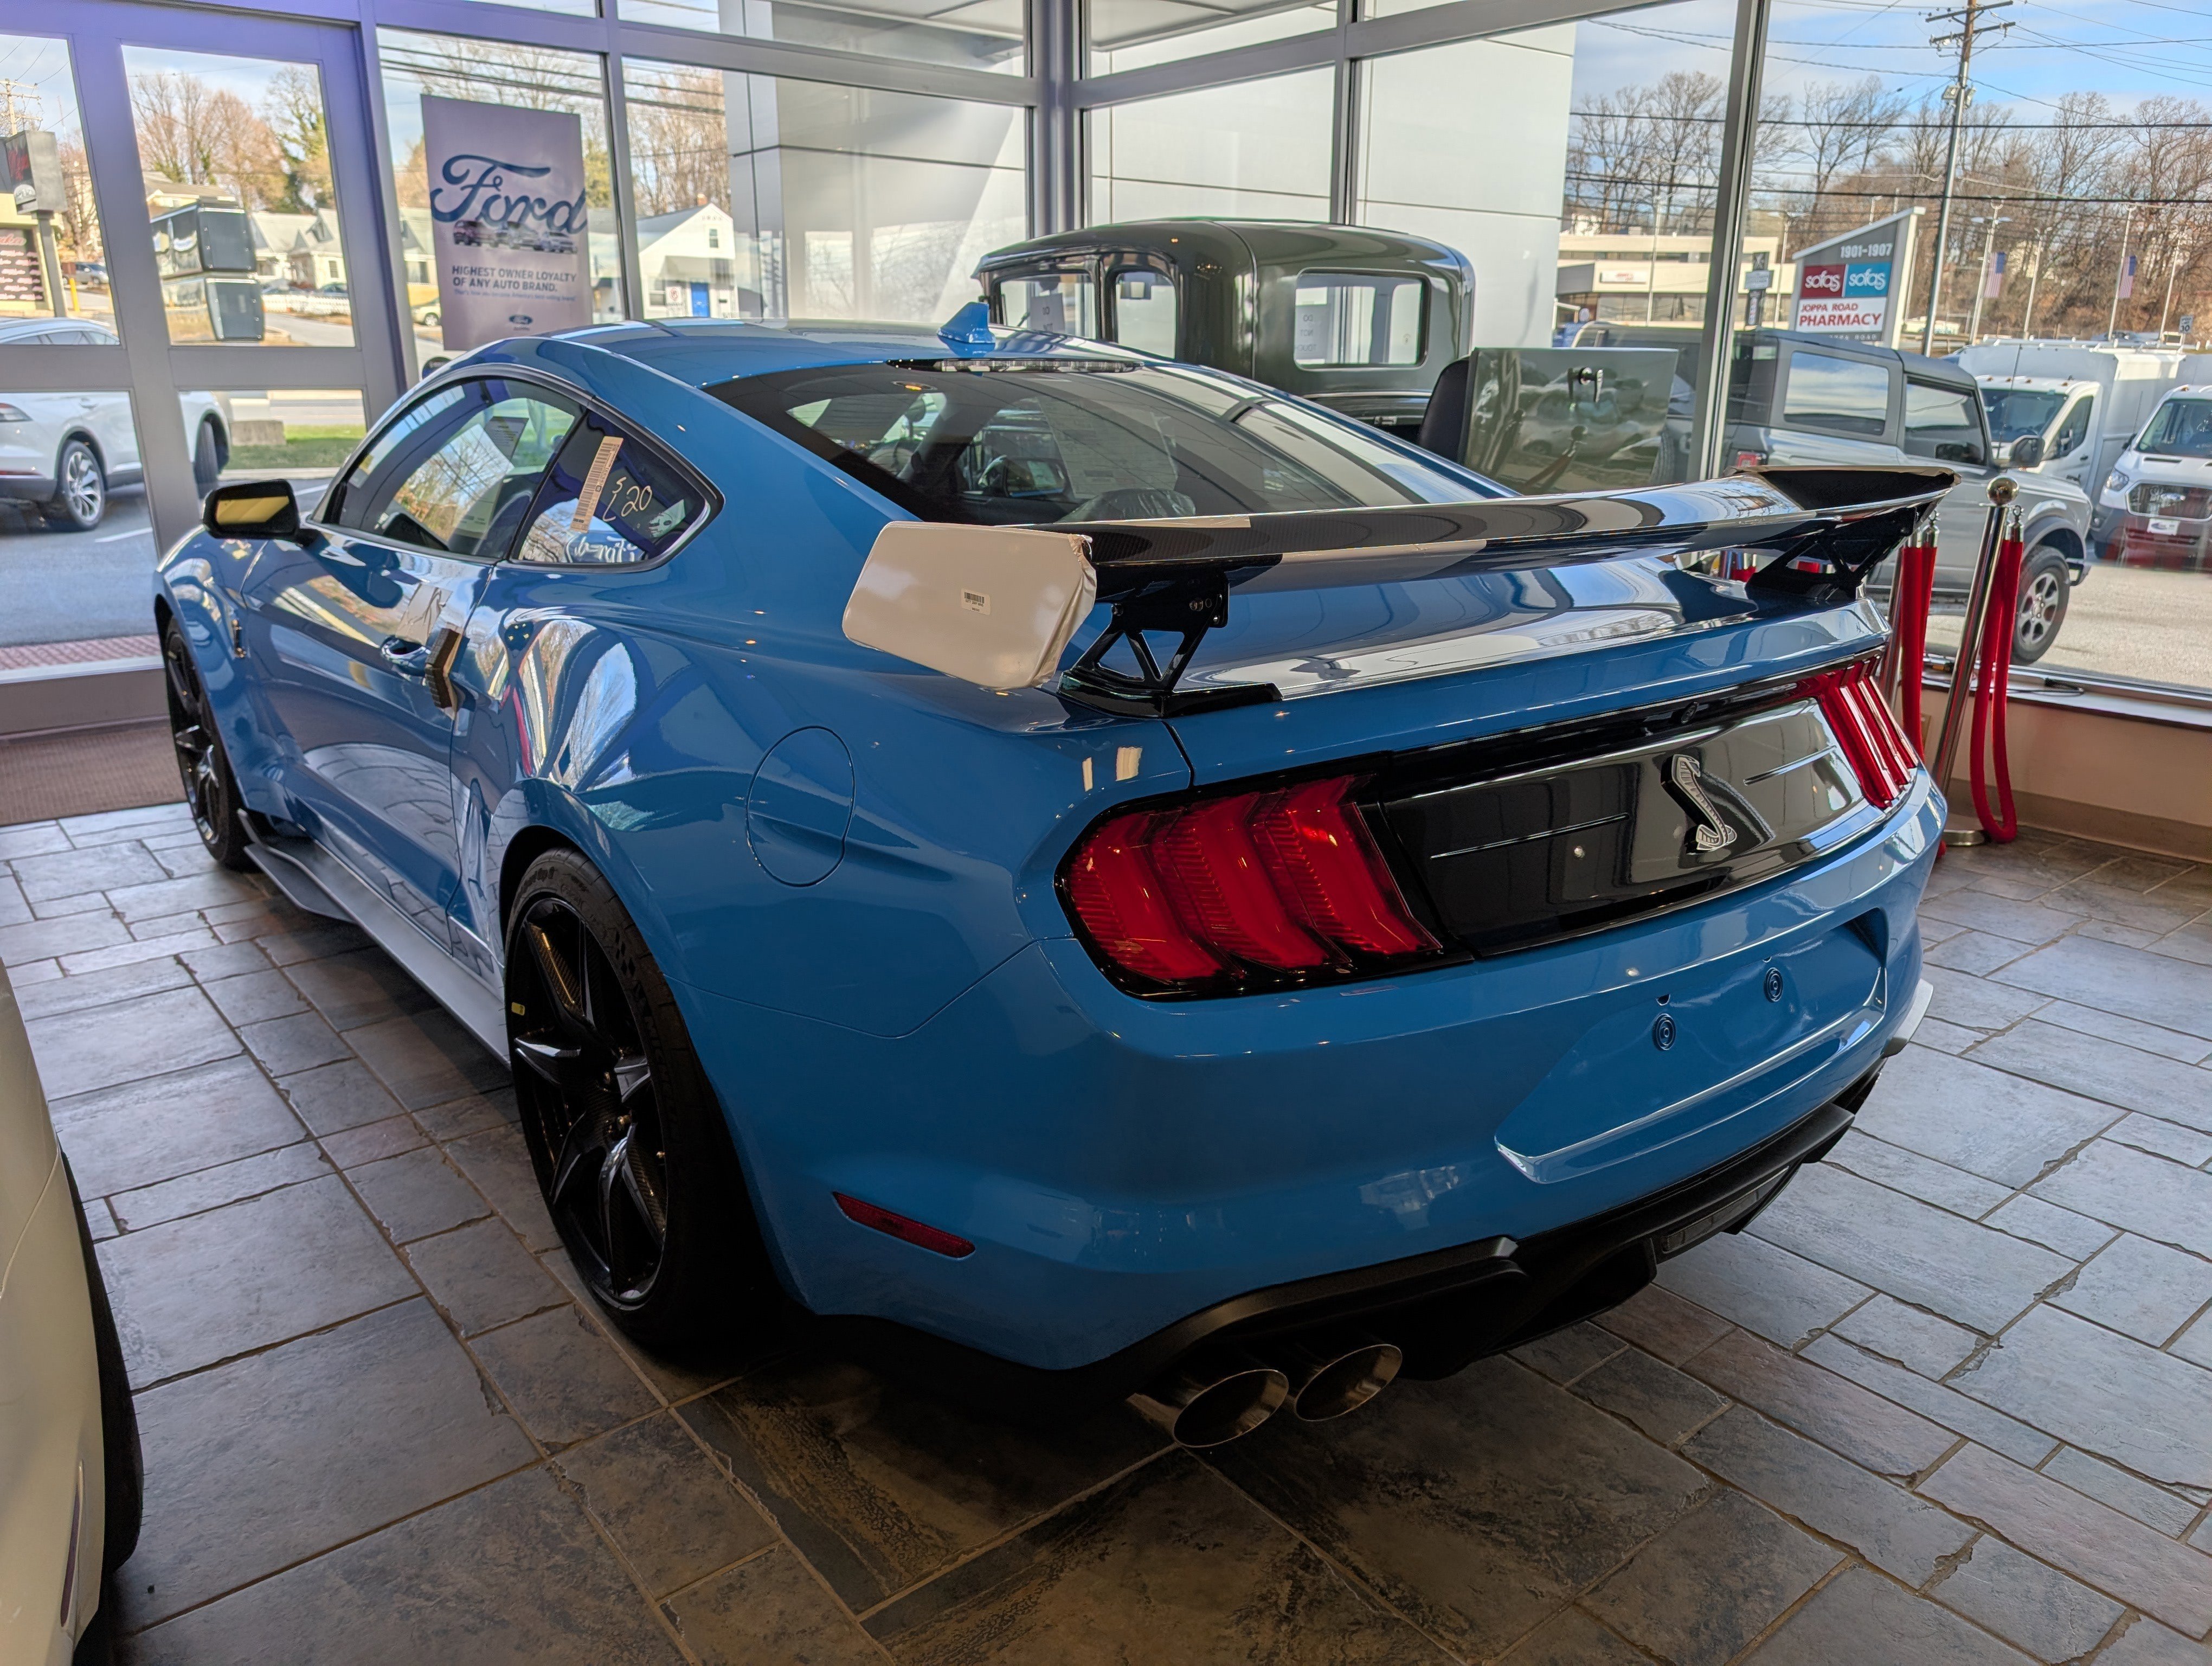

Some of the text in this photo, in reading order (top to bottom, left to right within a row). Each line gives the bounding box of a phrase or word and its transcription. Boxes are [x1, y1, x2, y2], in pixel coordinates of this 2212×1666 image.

[430, 155, 588, 233] Ford
[1840, 242, 1894, 258] 1901-1907
[452, 265, 577, 282] HIGHEST OWNER LOYALTY
[1805, 270, 1841, 292] sofas
[1848, 268, 1886, 290] sofas
[453, 277, 557, 292] OF ANY AUTO BRAND.
[1802, 303, 1859, 312] JOPPA ROAD
[1799, 312, 1882, 326] PHARMACY
